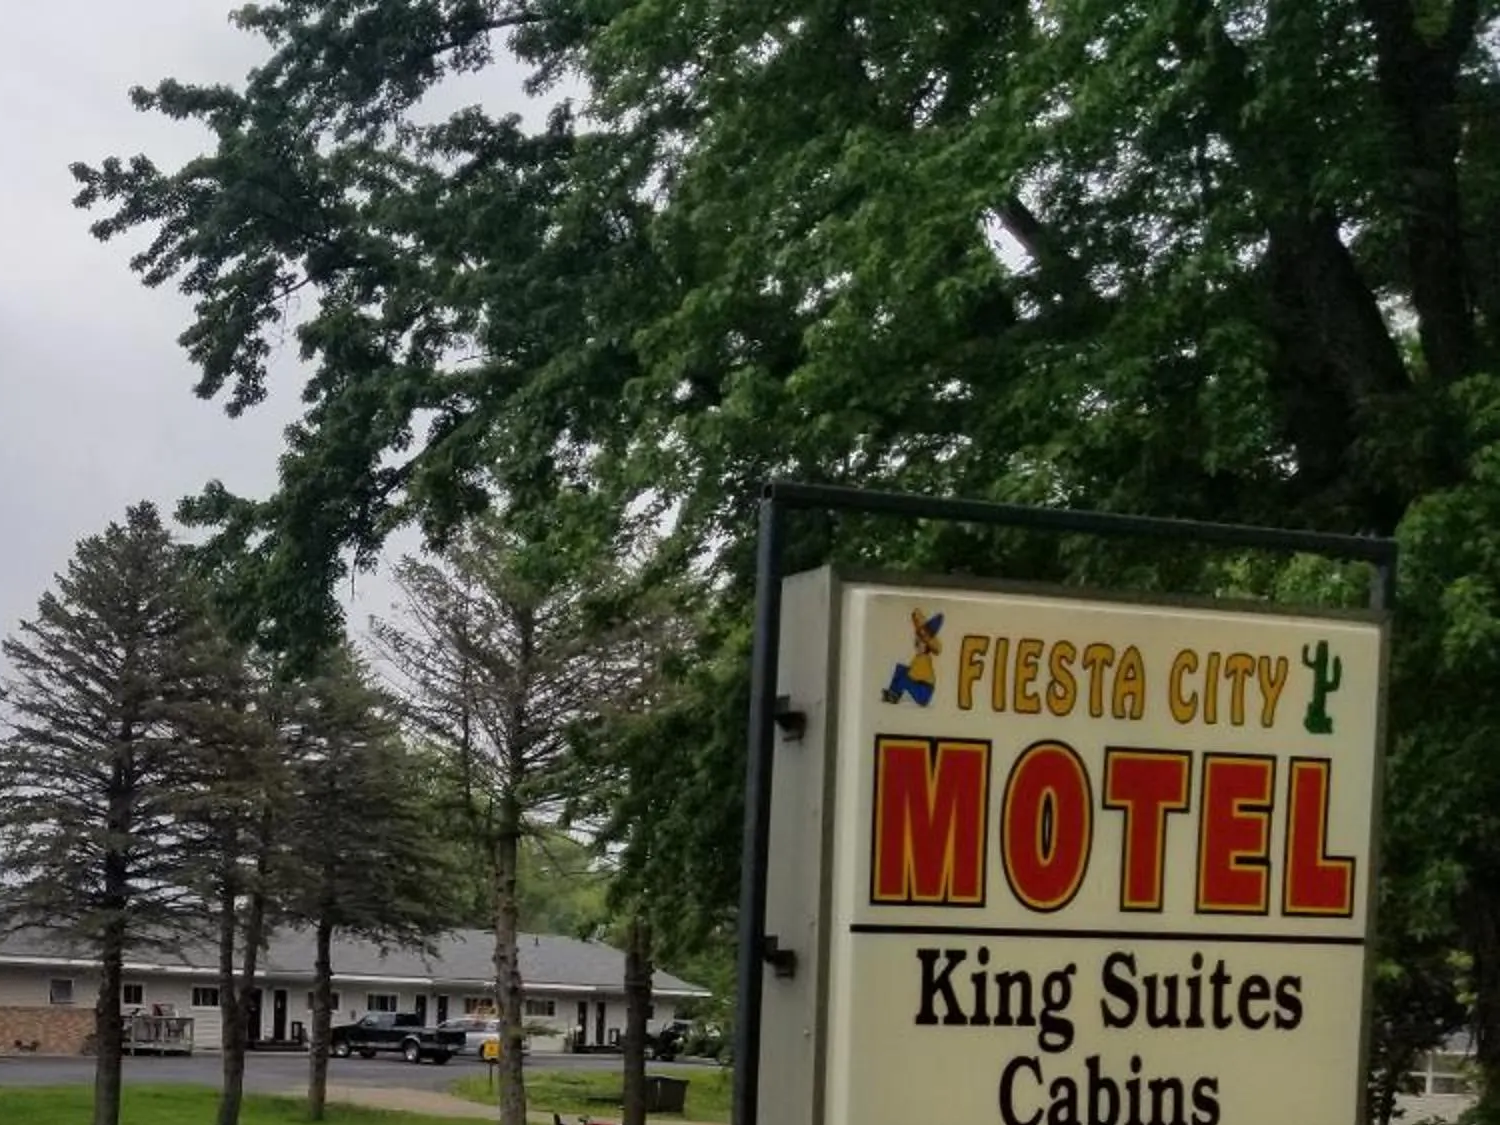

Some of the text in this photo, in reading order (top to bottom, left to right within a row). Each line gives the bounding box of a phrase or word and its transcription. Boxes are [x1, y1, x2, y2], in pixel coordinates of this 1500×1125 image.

[957, 635, 1288, 728] FIESTA CITY
[869, 734, 1356, 918] MOTEL
[914, 946, 1304, 1053] King Suites
